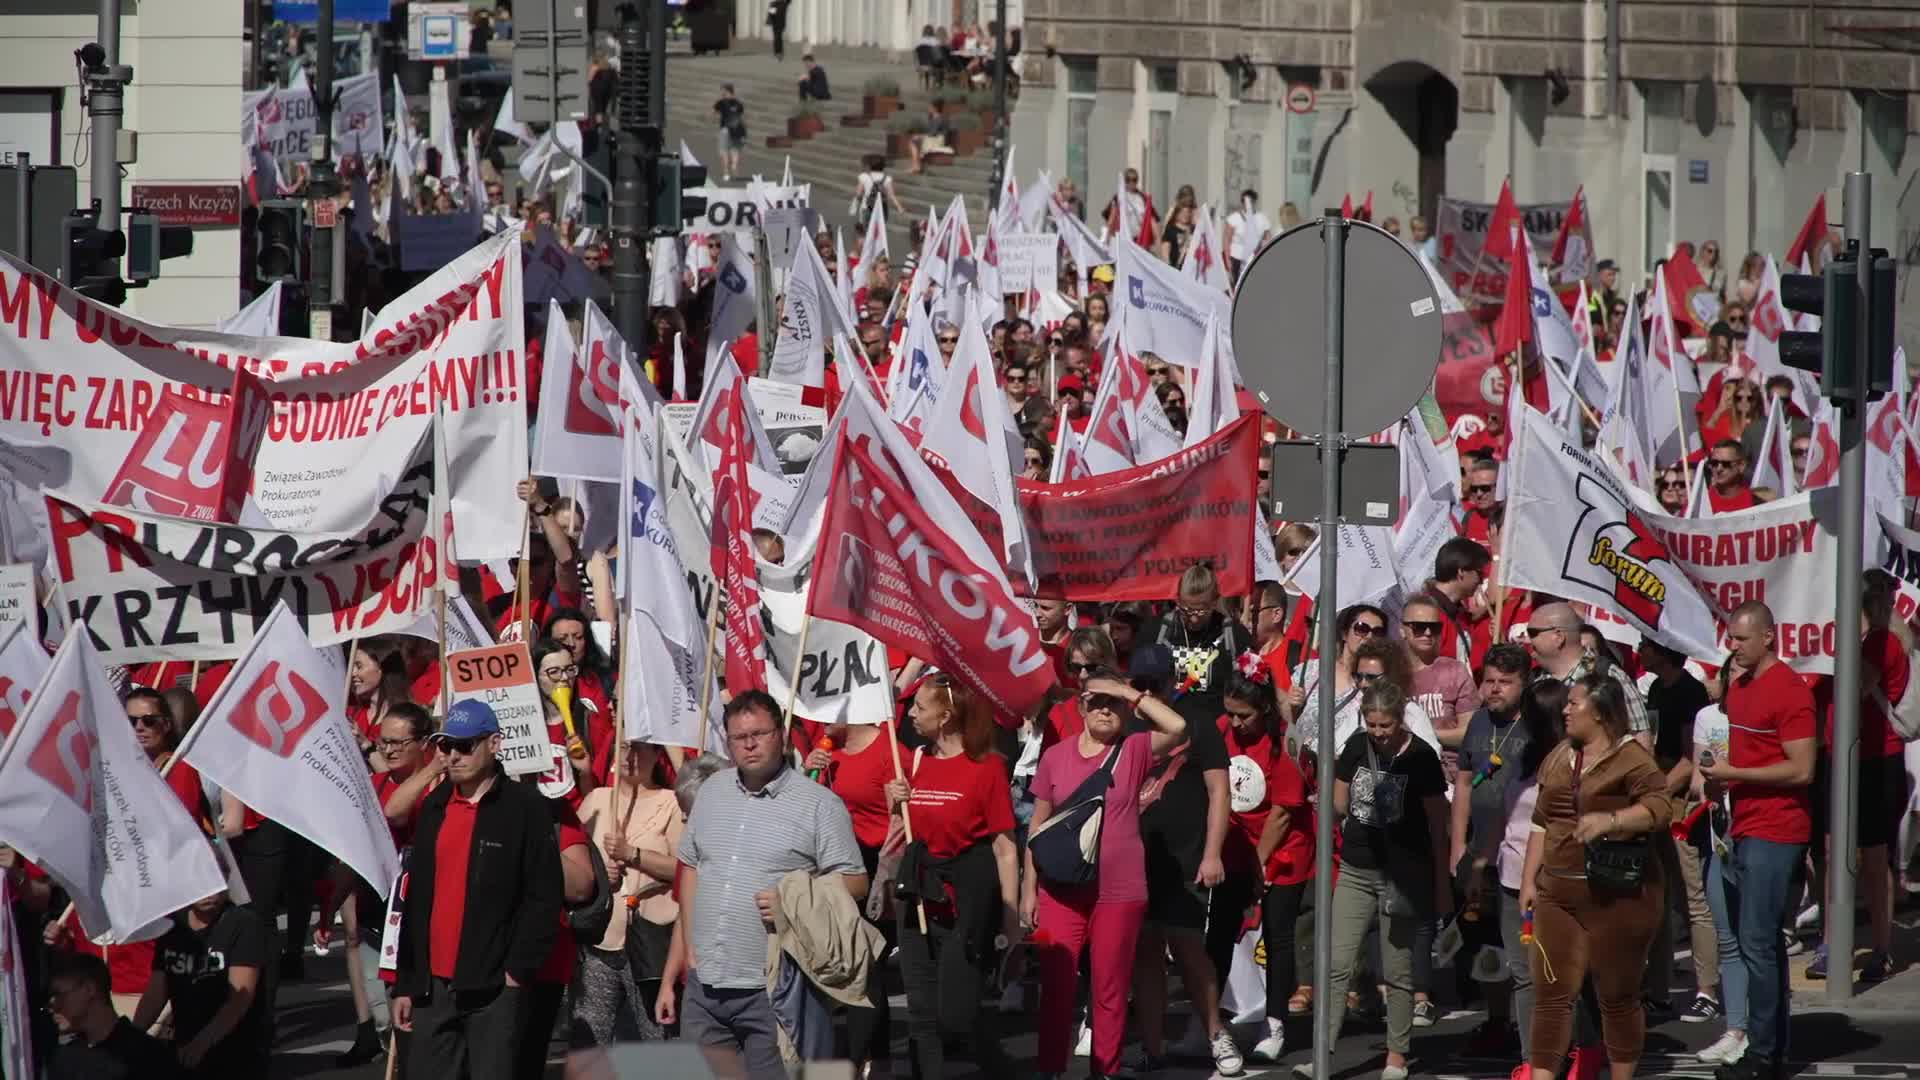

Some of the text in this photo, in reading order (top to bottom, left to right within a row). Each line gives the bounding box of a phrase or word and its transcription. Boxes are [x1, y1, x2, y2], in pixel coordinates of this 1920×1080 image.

[135, 193, 236, 214] Trzech Krzyży
[1561, 442, 1593, 468] FORUM
[1588, 536, 1667, 602] forum
[457, 653, 519, 683] STOP
[486, 688, 510, 703] DLA
[499, 723, 532, 740] SZYM
[496, 744, 537, 762] SZTEM
[124, 815, 152, 888] Zawodowy
